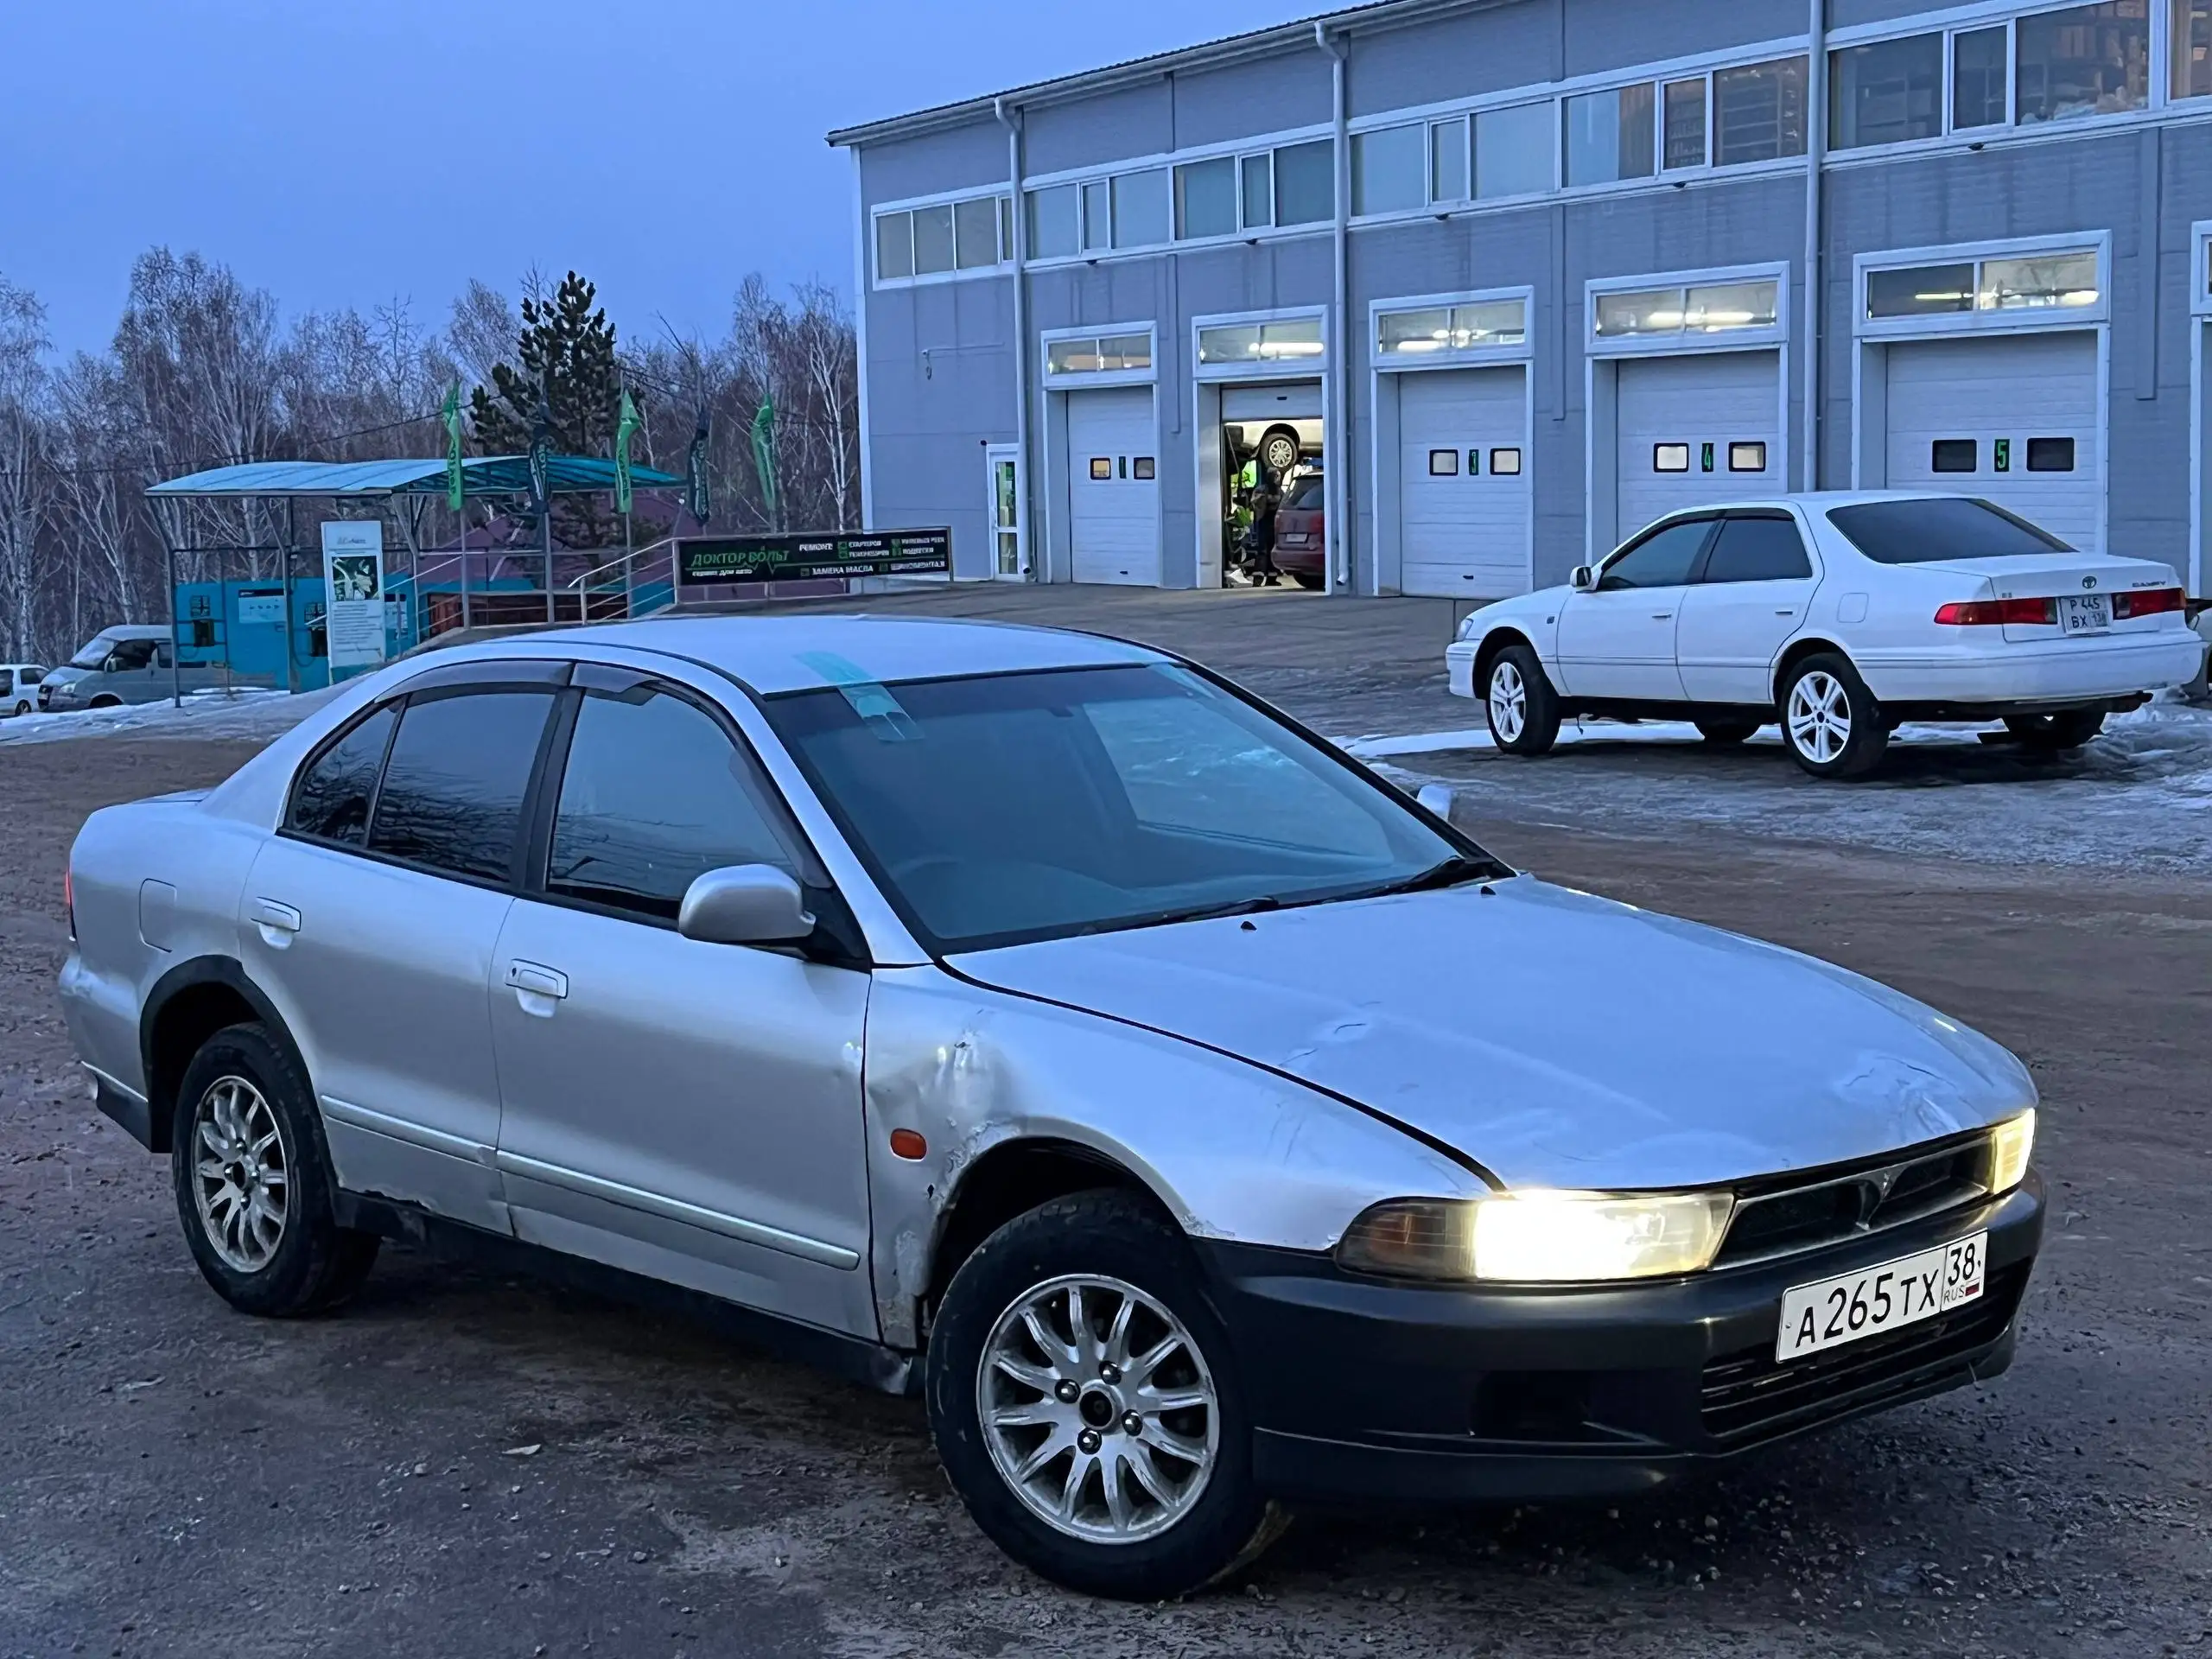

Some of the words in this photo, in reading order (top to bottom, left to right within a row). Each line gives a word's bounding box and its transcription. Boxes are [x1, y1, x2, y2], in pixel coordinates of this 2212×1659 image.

[1704, 444, 1711, 470] 4
[1997, 441, 2007, 469] 5
[691, 552, 747, 567] ДОКТОР
[748, 550, 791, 563] ВОЛЬТ
[1947, 1243, 1976, 1287] 38
[1943, 1285, 1965, 1305] RUS
